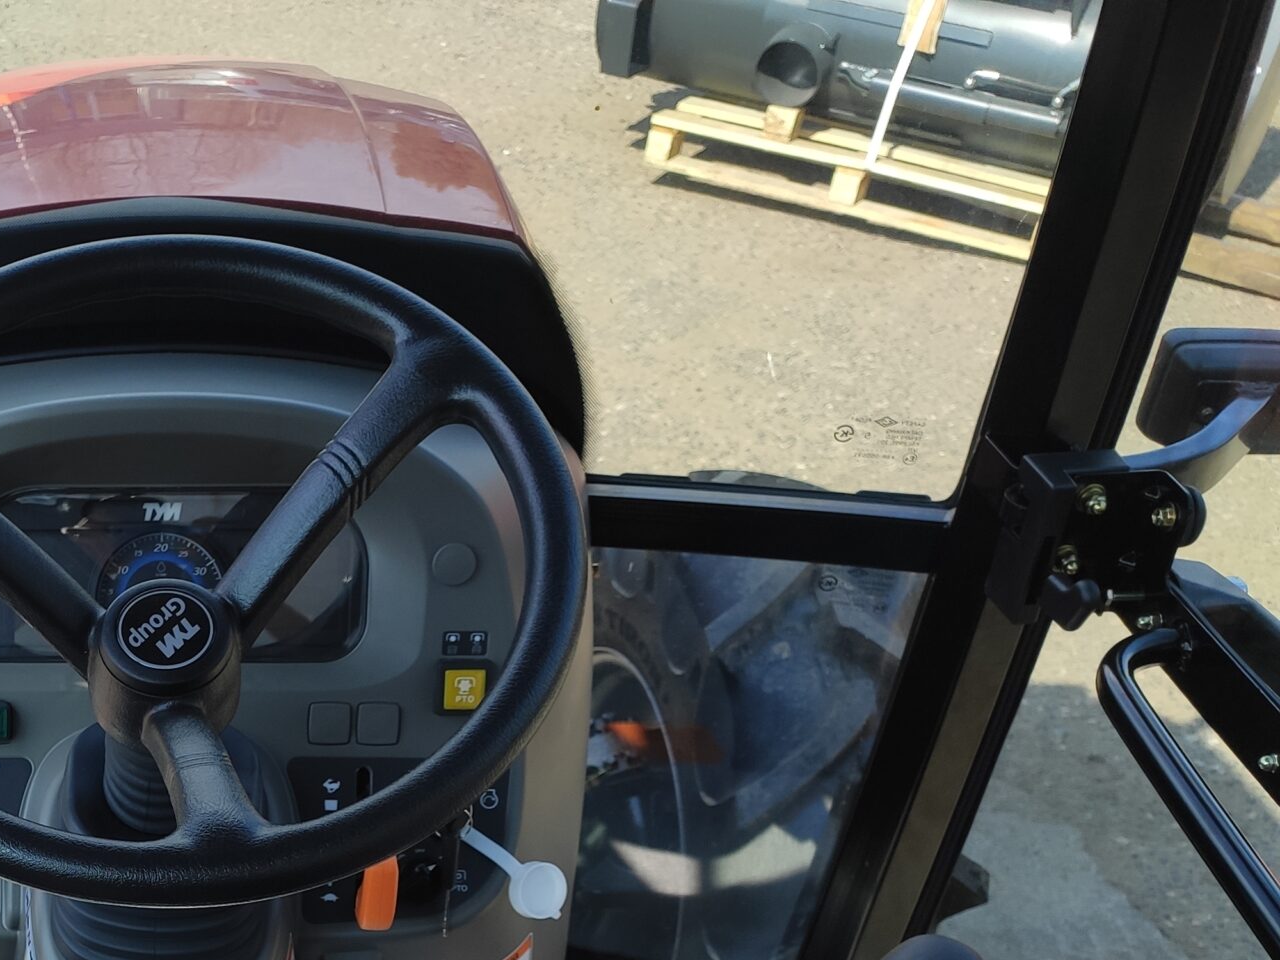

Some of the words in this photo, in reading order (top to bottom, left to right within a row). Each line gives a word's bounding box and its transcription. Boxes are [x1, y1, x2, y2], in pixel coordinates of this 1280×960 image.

[142, 502, 183, 522] TYM
[153, 543, 169, 553] 20
[117, 566, 129, 575] 10
[193, 566, 207, 576] 30
[128, 597, 186, 648] Group
[155, 618, 201, 659] TYM
[455, 695, 475, 704] PTO
